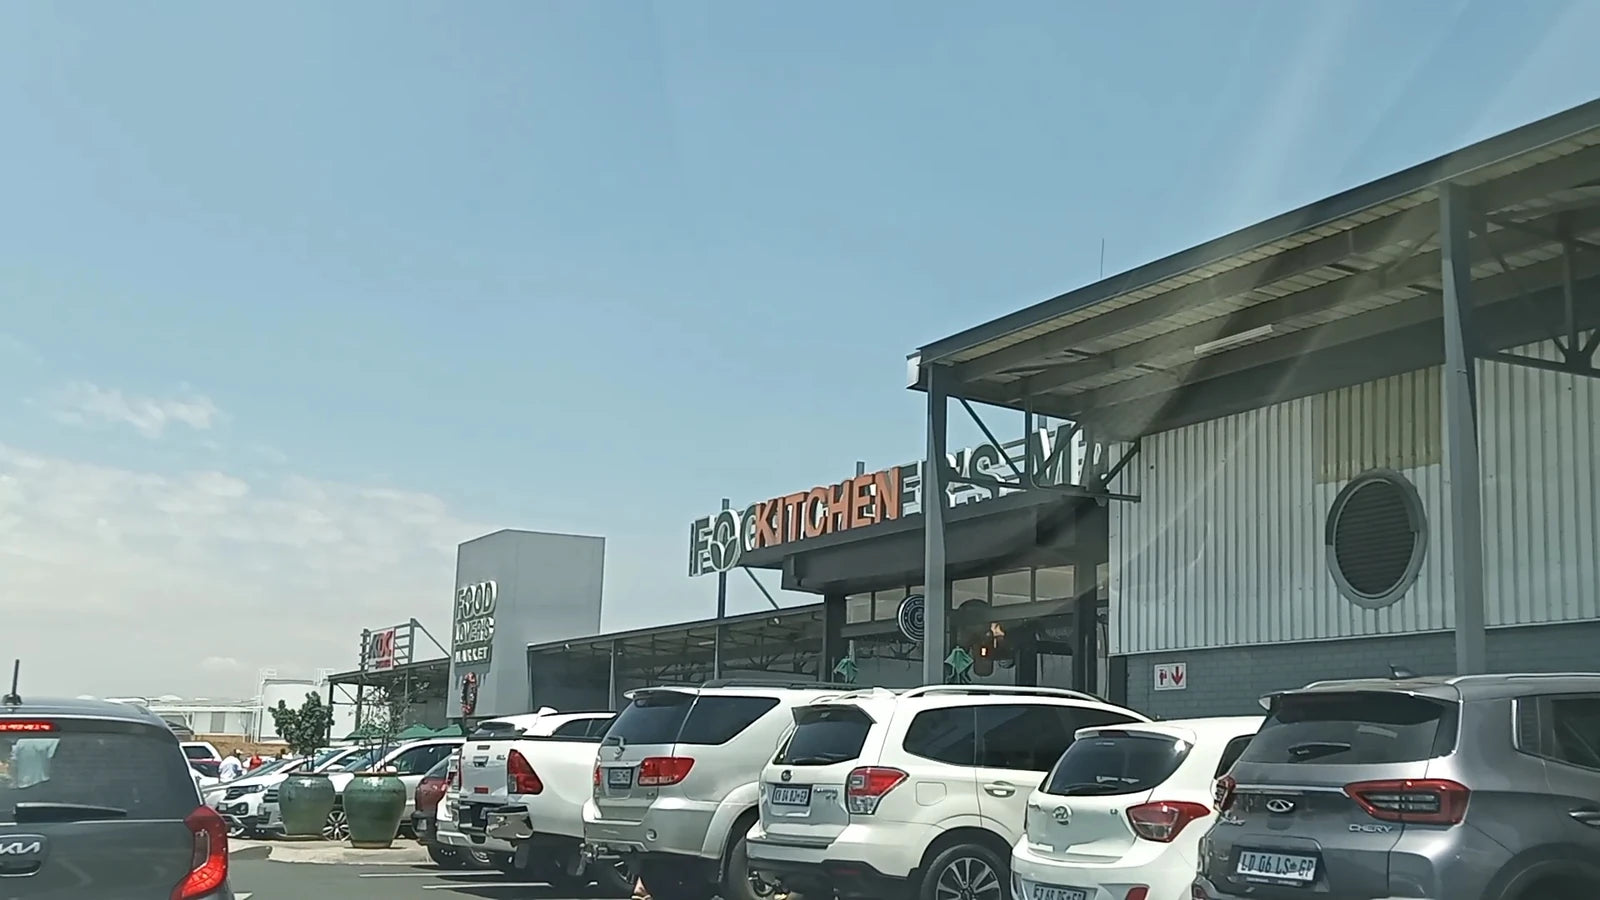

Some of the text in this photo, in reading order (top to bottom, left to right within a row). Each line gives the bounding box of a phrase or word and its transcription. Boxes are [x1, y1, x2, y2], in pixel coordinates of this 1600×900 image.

[755, 466, 900, 549] KITCHEN
[456, 580, 498, 620] FOOD
[455, 646, 489, 663] MARKET
[1348, 823, 1393, 834] CHERY
[1298, 859, 1314, 877] GP
